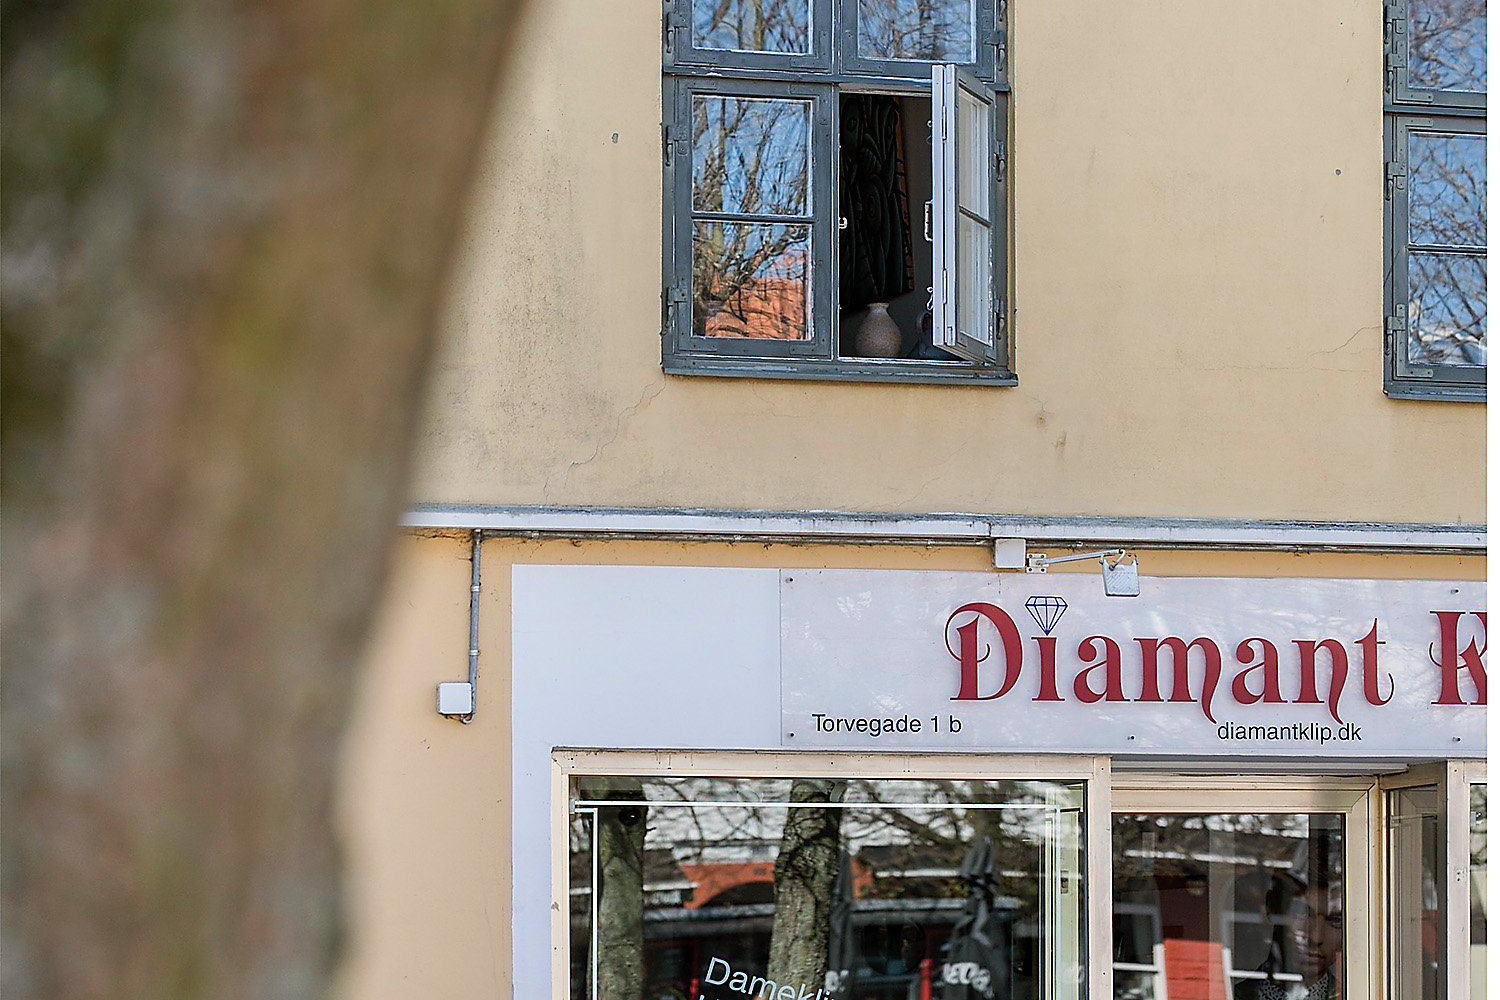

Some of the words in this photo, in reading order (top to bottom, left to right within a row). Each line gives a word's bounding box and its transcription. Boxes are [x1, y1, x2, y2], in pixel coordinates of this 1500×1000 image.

[945, 602, 1394, 725] Diamant
[812, 713, 922, 737] Torvegade
[930, 715, 940, 733] 1
[949, 714, 962, 733] b
[1217, 722, 1361, 743] diamantklip.dk
